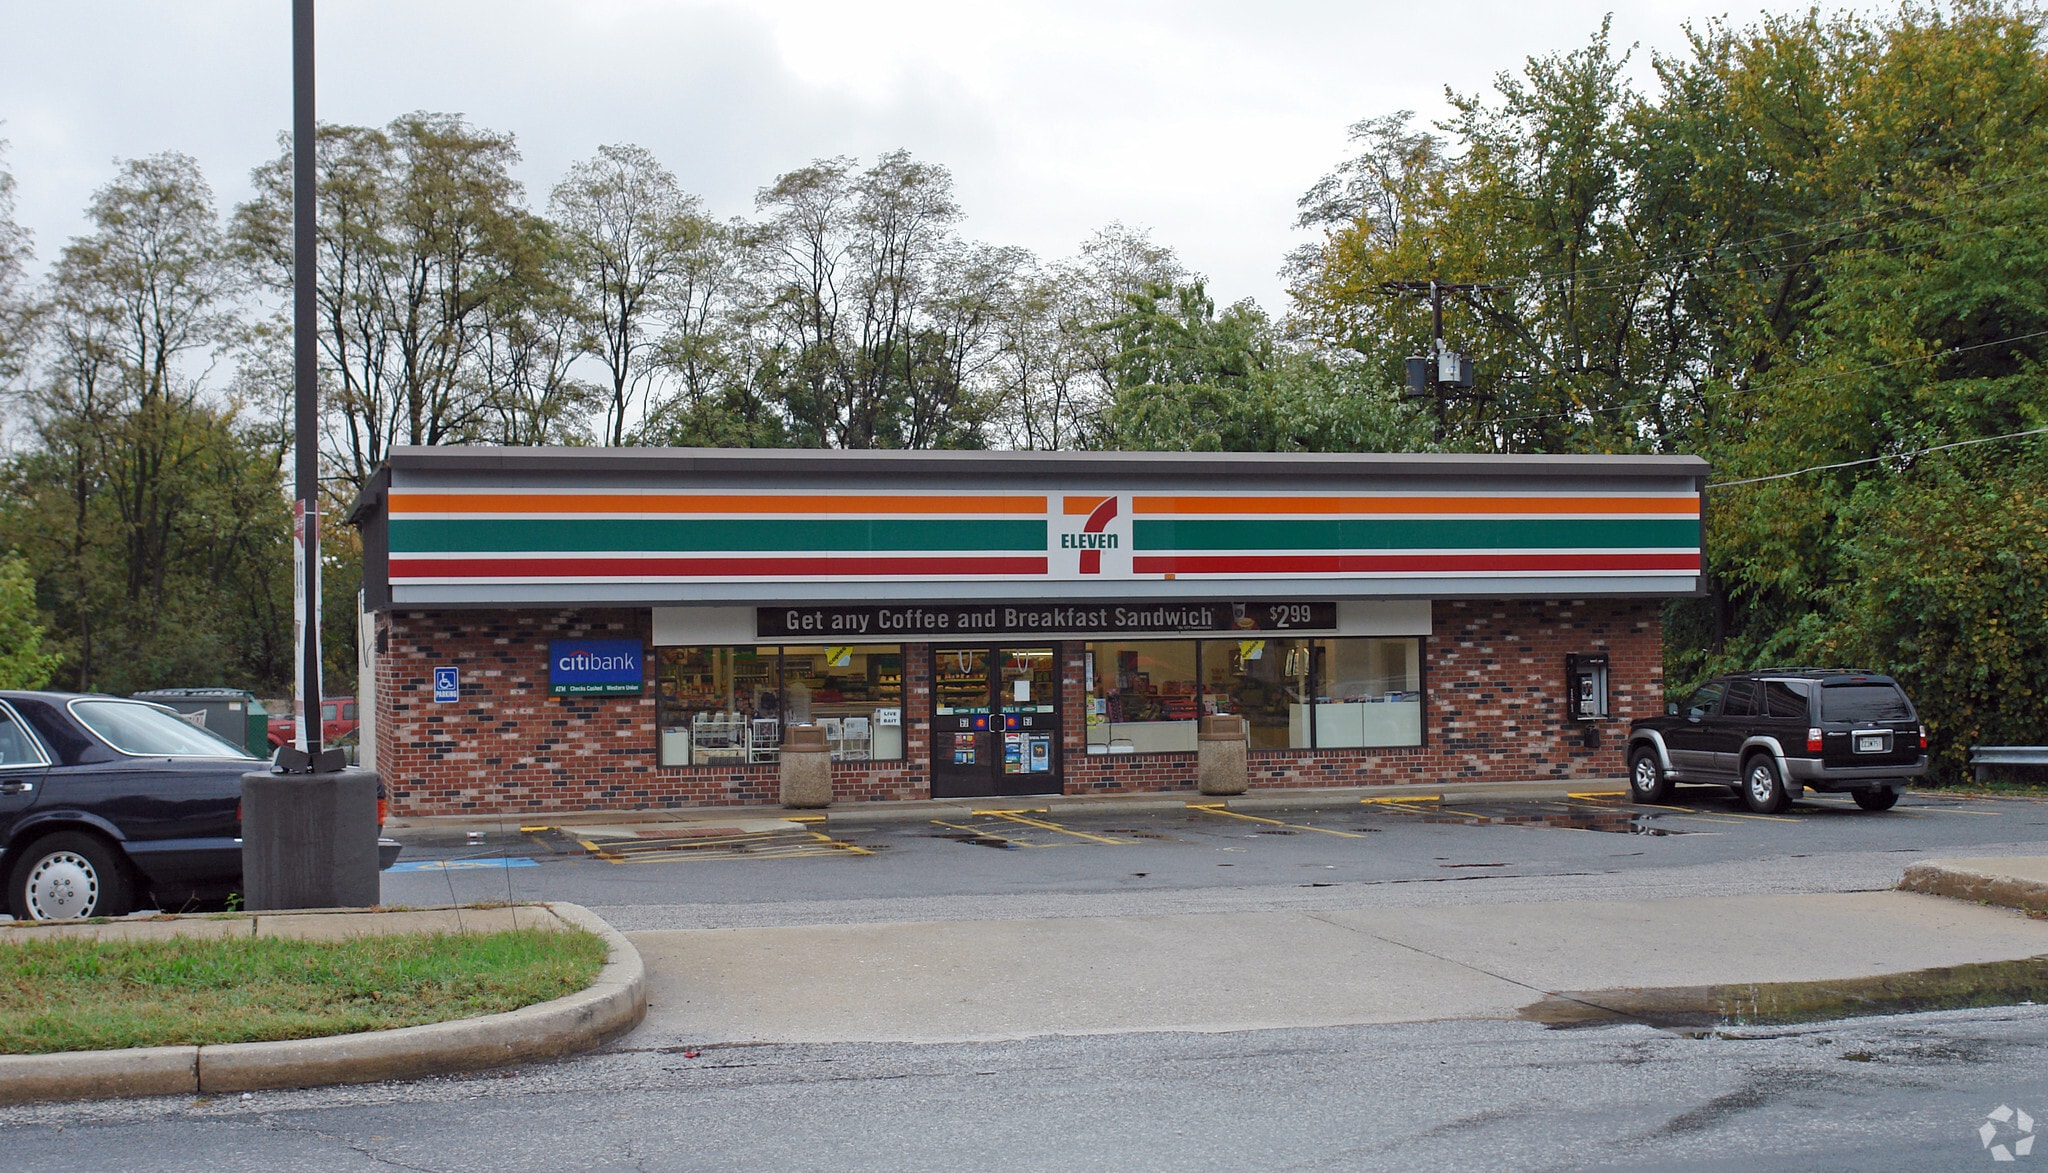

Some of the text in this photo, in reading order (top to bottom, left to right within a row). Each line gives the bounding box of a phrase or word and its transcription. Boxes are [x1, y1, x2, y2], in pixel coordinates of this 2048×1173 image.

[1063, 496, 1117, 574] 7
[786, 610, 823, 630] Get
[832, 614, 870, 633] any
[878, 609, 949, 629] Coffee
[957, 608, 996, 628] and
[1005, 607, 1108, 627] Breakfast
[1115, 607, 1212, 627] Sandwich
[559, 651, 635, 671] citibank
[435, 690, 457, 698] PARKING
